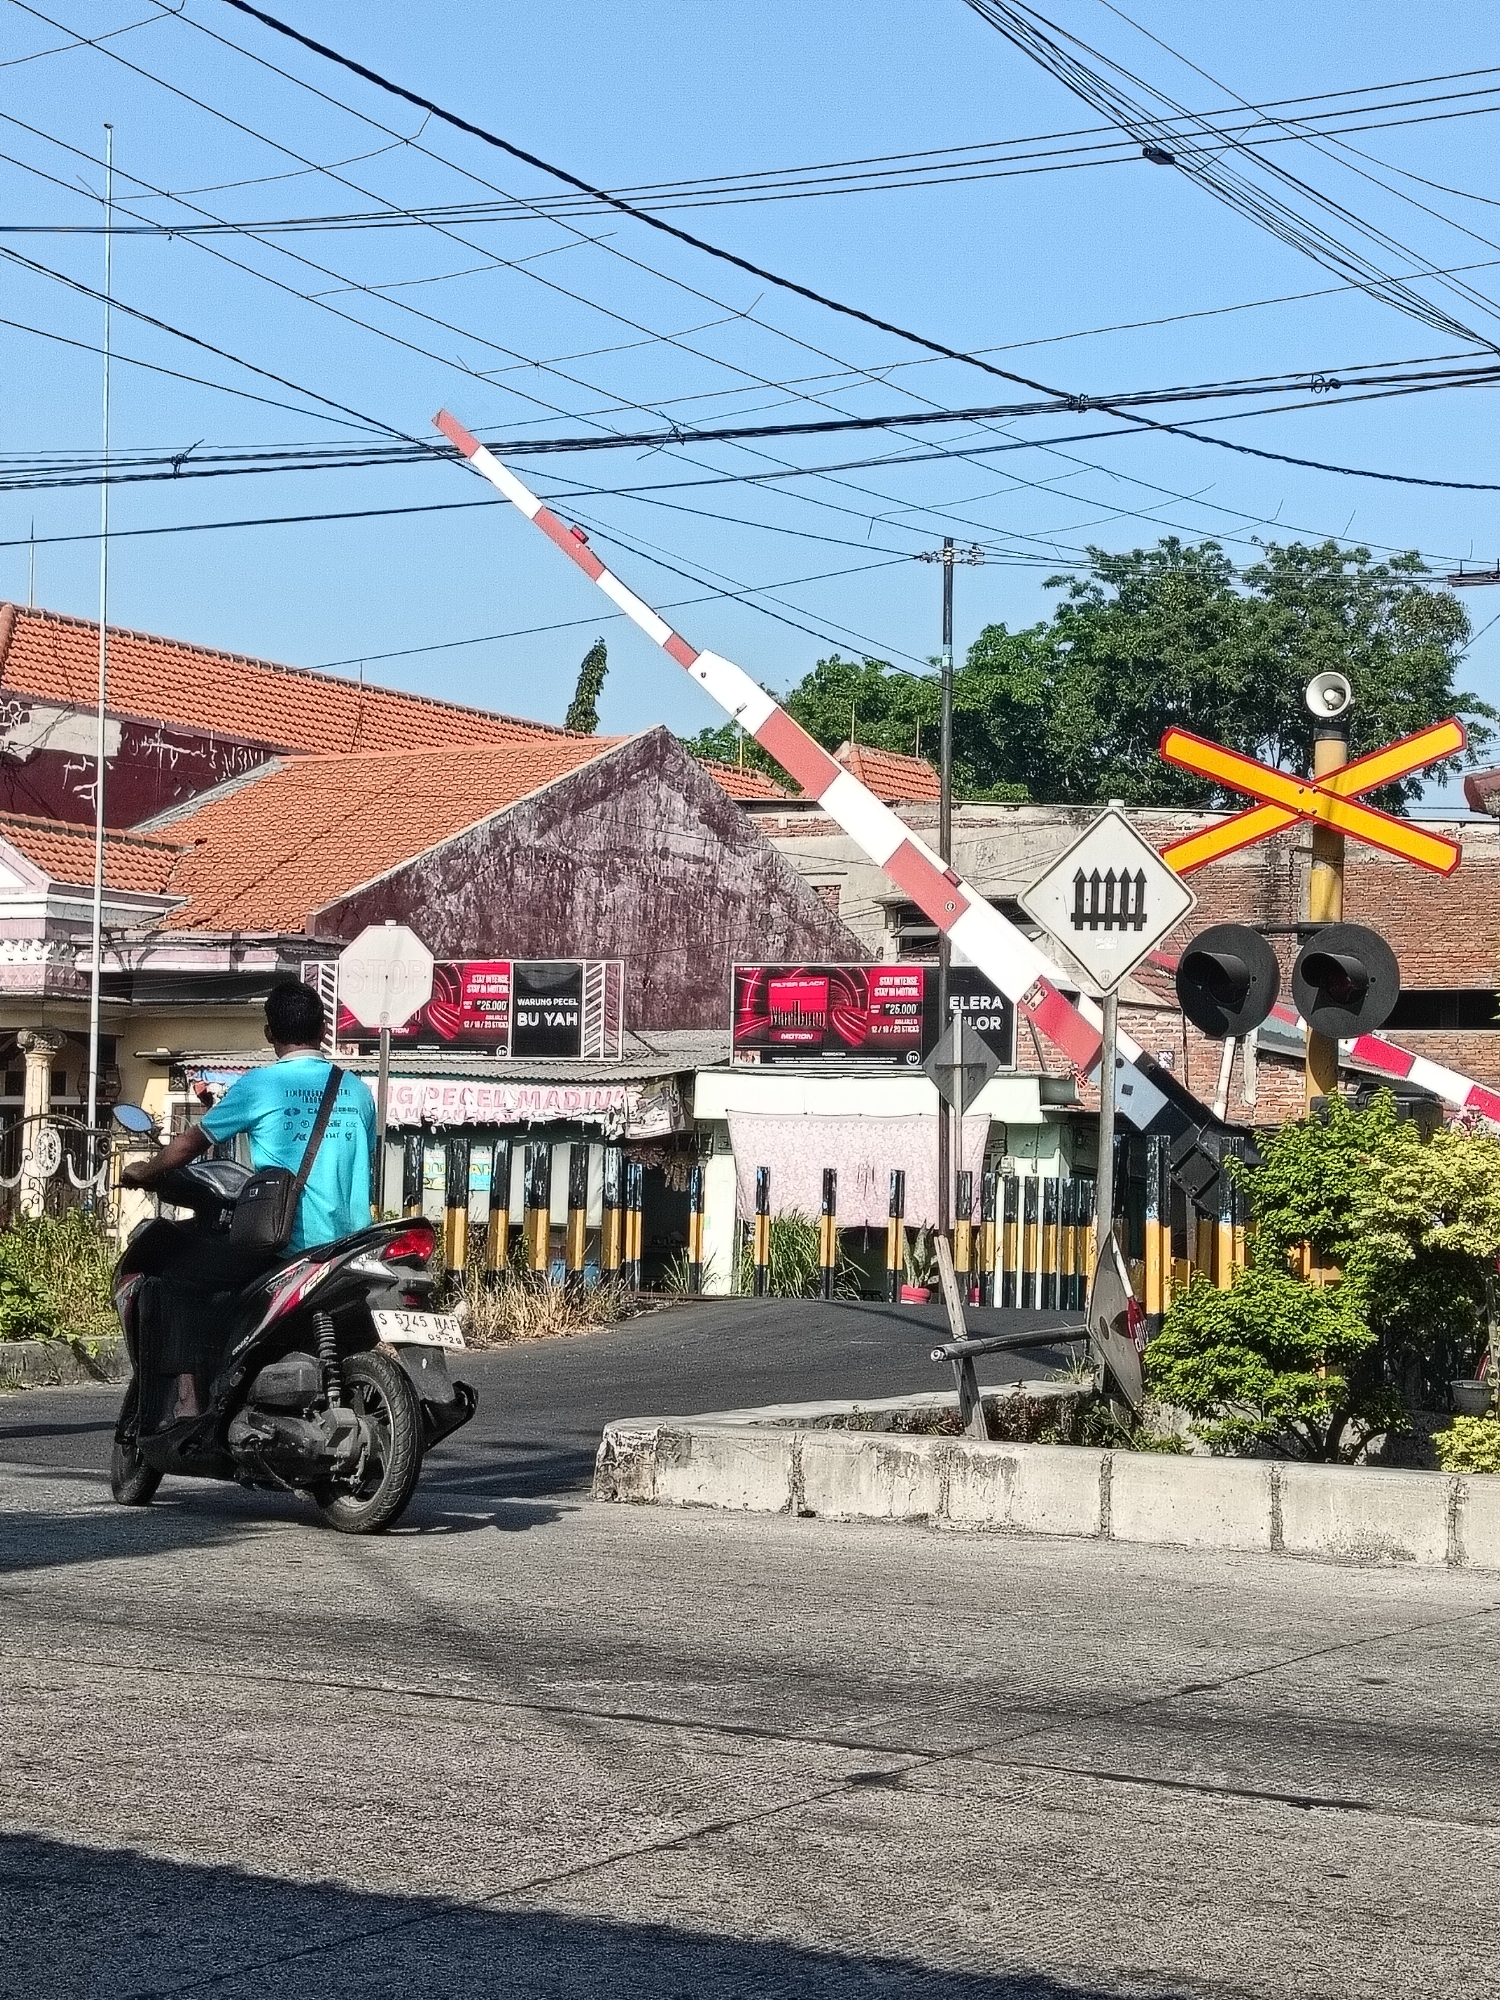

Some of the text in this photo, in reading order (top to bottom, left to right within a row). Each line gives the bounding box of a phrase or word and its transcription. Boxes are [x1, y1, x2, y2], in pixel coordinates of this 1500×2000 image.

[346, 958, 426, 995] STOP
[879, 976, 893, 986] STAY
[874, 988, 889, 996] STAY
[517, 998, 578, 1006] WARUNG PECEL
[517, 1012, 578, 1026] BU YAH
[378, 1312, 387, 1325] S
[434, 1316, 457, 1331] NAF
